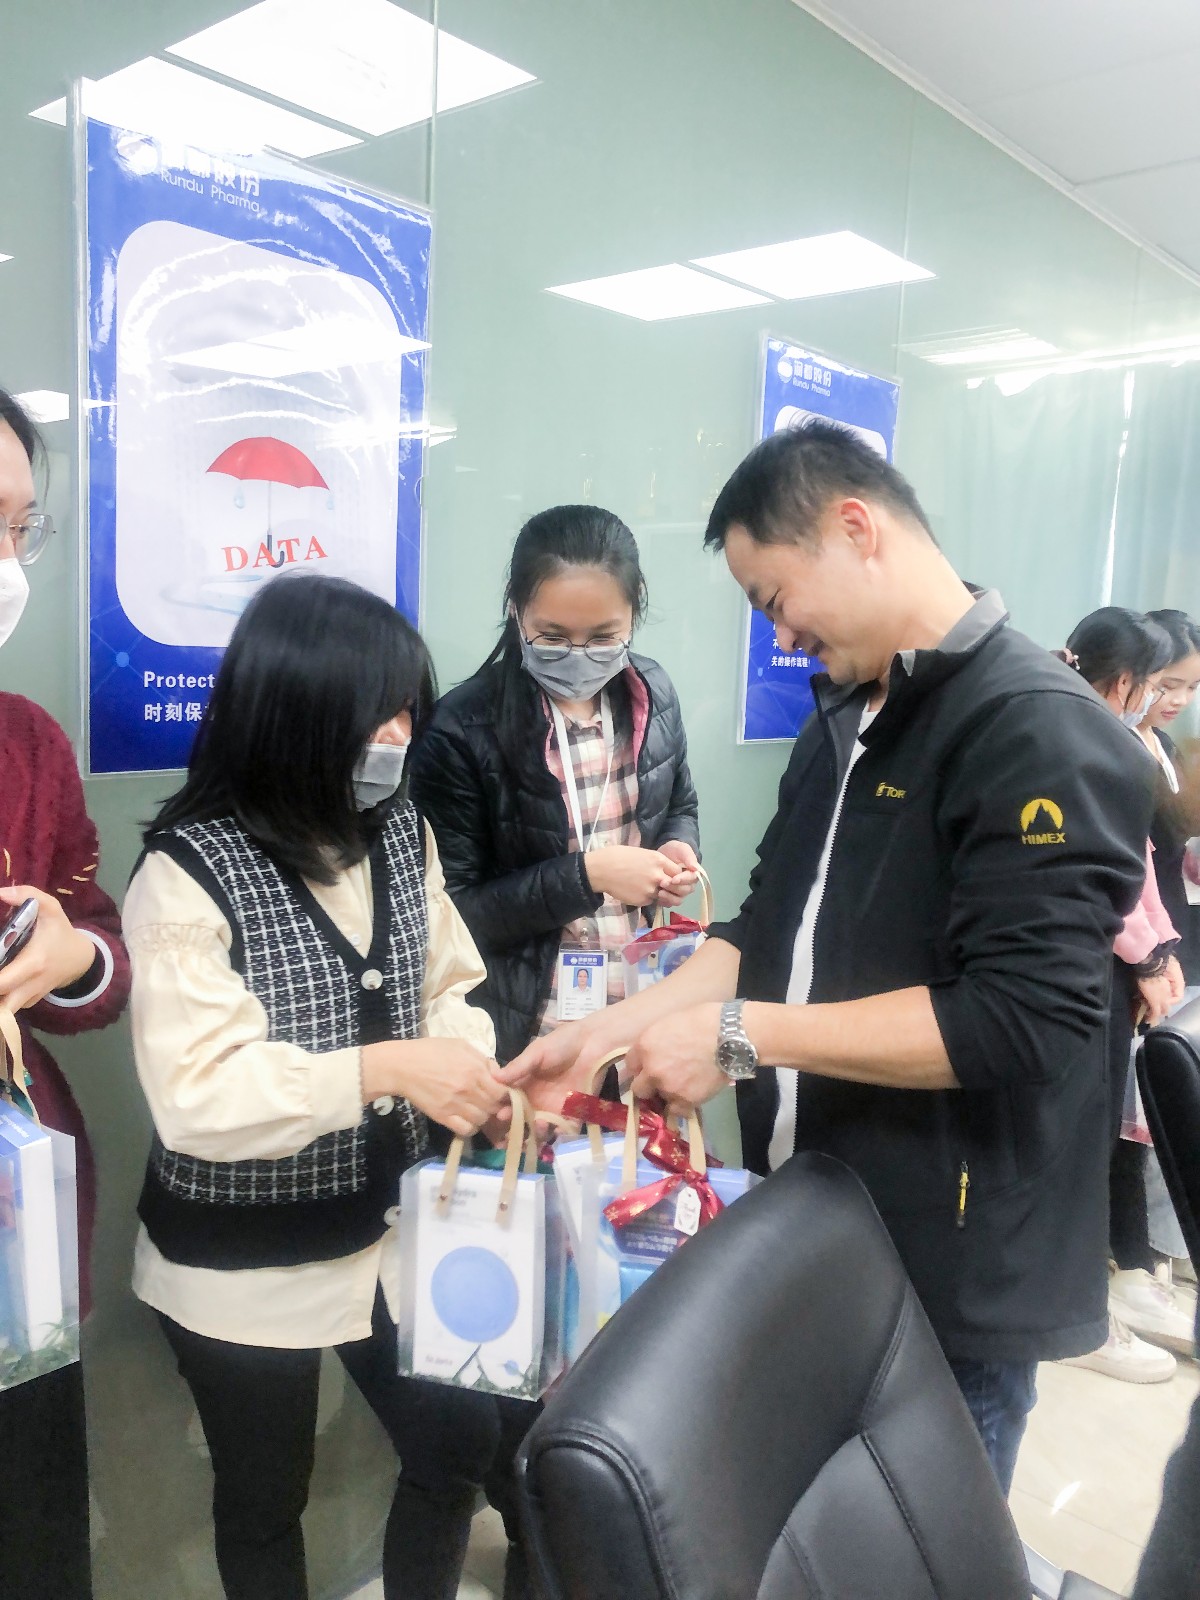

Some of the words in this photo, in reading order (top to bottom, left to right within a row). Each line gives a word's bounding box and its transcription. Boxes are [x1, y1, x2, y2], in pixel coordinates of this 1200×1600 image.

[161, 168, 204, 195] Rundu
[211, 185, 260, 212] Pharma
[221, 535, 328, 572] DATA
[144, 671, 216, 688] Protect
[144, 702, 214, 722] 时刻保
[1021, 832, 1066, 845] HIMEX
